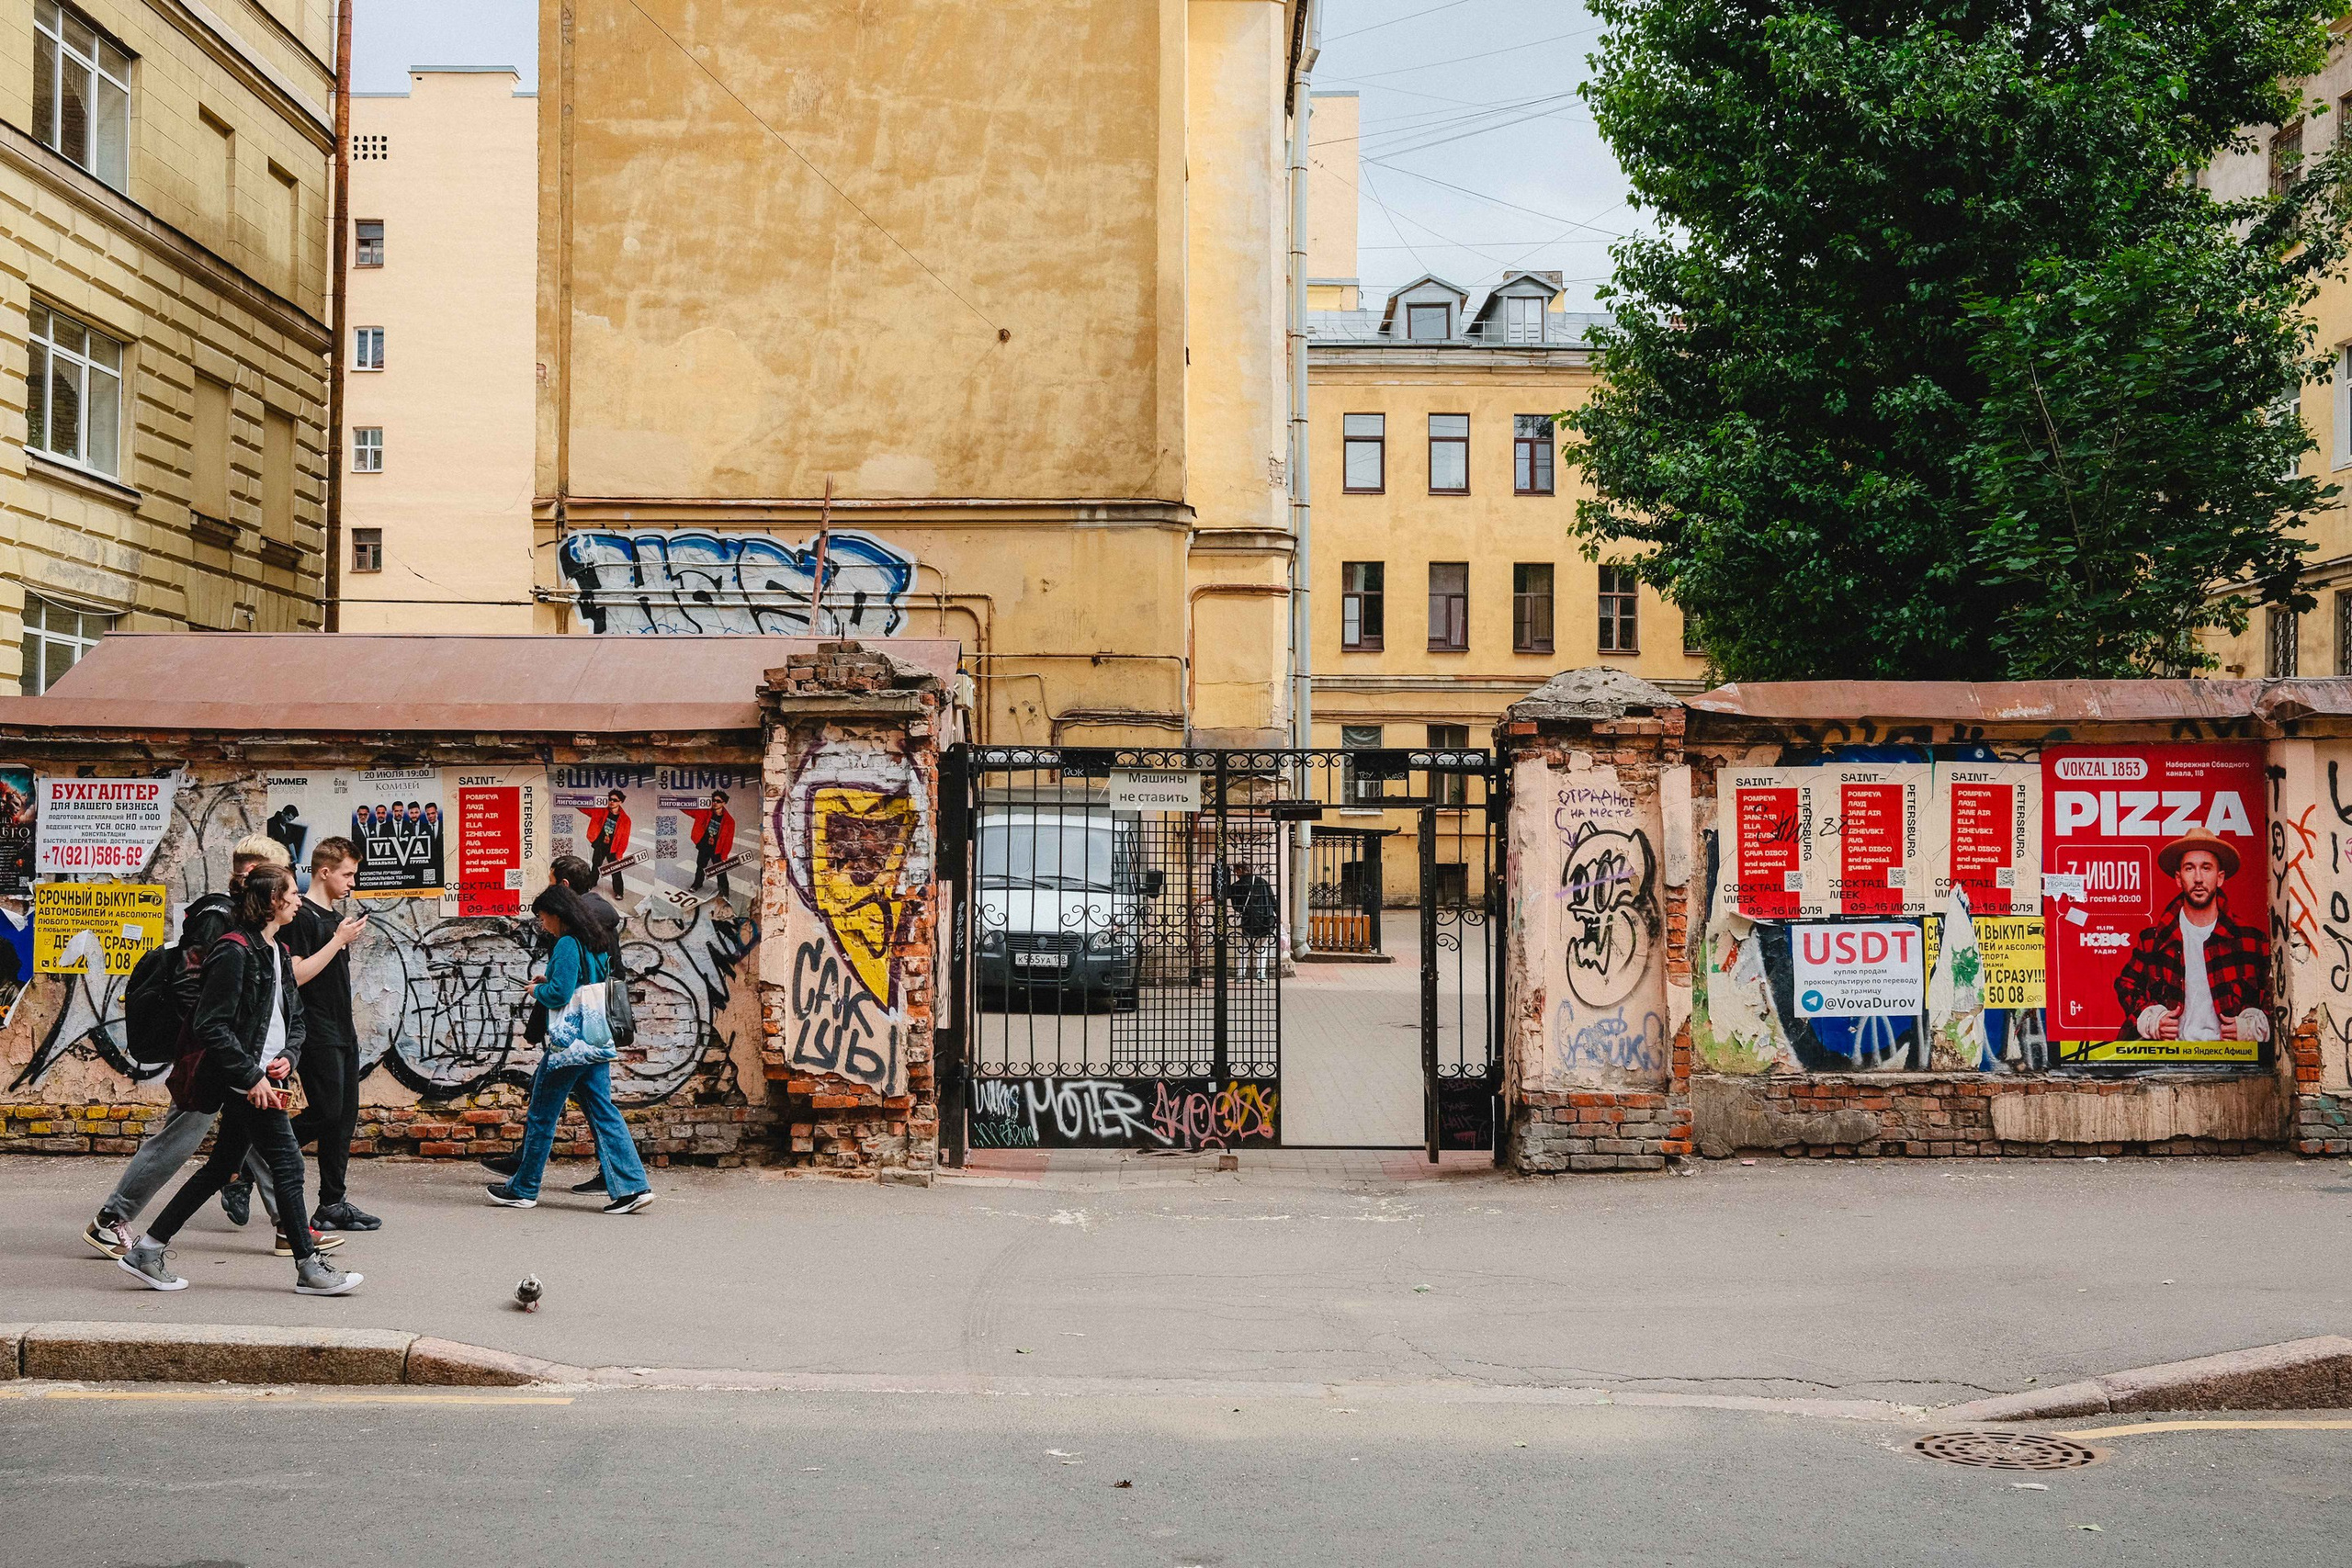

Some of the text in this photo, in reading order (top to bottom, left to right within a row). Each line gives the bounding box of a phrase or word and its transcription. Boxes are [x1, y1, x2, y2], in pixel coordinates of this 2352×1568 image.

[406, 770, 430, 778] 19:00
[2063, 761, 2141, 776] VOKZAL 1853
[459, 776, 503, 785] SAINT-
[555, 768, 565, 788] das
[658, 770, 668, 790] das
[1128, 773, 1187, 784] Машины
[1736, 778, 1781, 786] SAINT-
[1841, 773, 1886, 782] SAINT-
[1951, 773, 1996, 782] SAINT-
[51, 784, 159, 800] БУХГАЛТЕР
[596, 797, 608, 806] 80
[699, 798, 712, 807] 80
[1119, 793, 1189, 803] не ставить
[51, 802, 70, 811] ДЛЯ
[116, 803, 159, 811] БИЗНЕСА
[2054, 791, 2254, 836] PIZZA
[524, 786, 533, 860] PETERSBURG
[1803, 787, 1812, 861] PETERSBURG
[1907, 784, 1916, 858] PETERSBURG
[2017, 784, 2026, 858] PETERSBURG
[480, 858, 507, 866] special
[636, 852, 647, 863] 18
[741, 852, 752, 863] 18
[1862, 856, 1890, 864] special
[2086, 861, 2141, 890] ИЮЛЯ
[445, 882, 504, 891] COCKTAIL
[1724, 884, 1784, 893] COCKTAIL
[39, 886, 135, 907] СРОЧНЫЙ ВЫКУП
[445, 893, 477, 902] WEEK
[664, 890, 698, 908] -50
[1724, 895, 1757, 904] WEEK
[2089, 895, 2117, 903] гостей
[2119, 895, 2142, 903] 20:00
[39, 906, 106, 917] АВТОМОБИЛЕЙ
[1788, 906, 1823, 915] ИЮЛЯ
[1890, 902, 1926, 911] ИЮЛЯ
[1998, 903, 2033, 912] ИЮЛЯ
[1984, 924, 2025, 940] ВЫКУП
[1804, 931, 1916, 964] USDT
[115, 953, 130, 969] 08
[1996, 970, 2045, 983] СРАЗУ!!!
[1989, 986, 2024, 1003] 50 08
[1825, 998, 1916, 1010] @VovaDurov
[2070, 1000, 2083, 1016] 6+
[2116, 1046, 2179, 1055] БИЛЕТЫ
[2194, 1047, 2222, 1056] Яндекс
[2224, 1047, 2253, 1055] Афише
